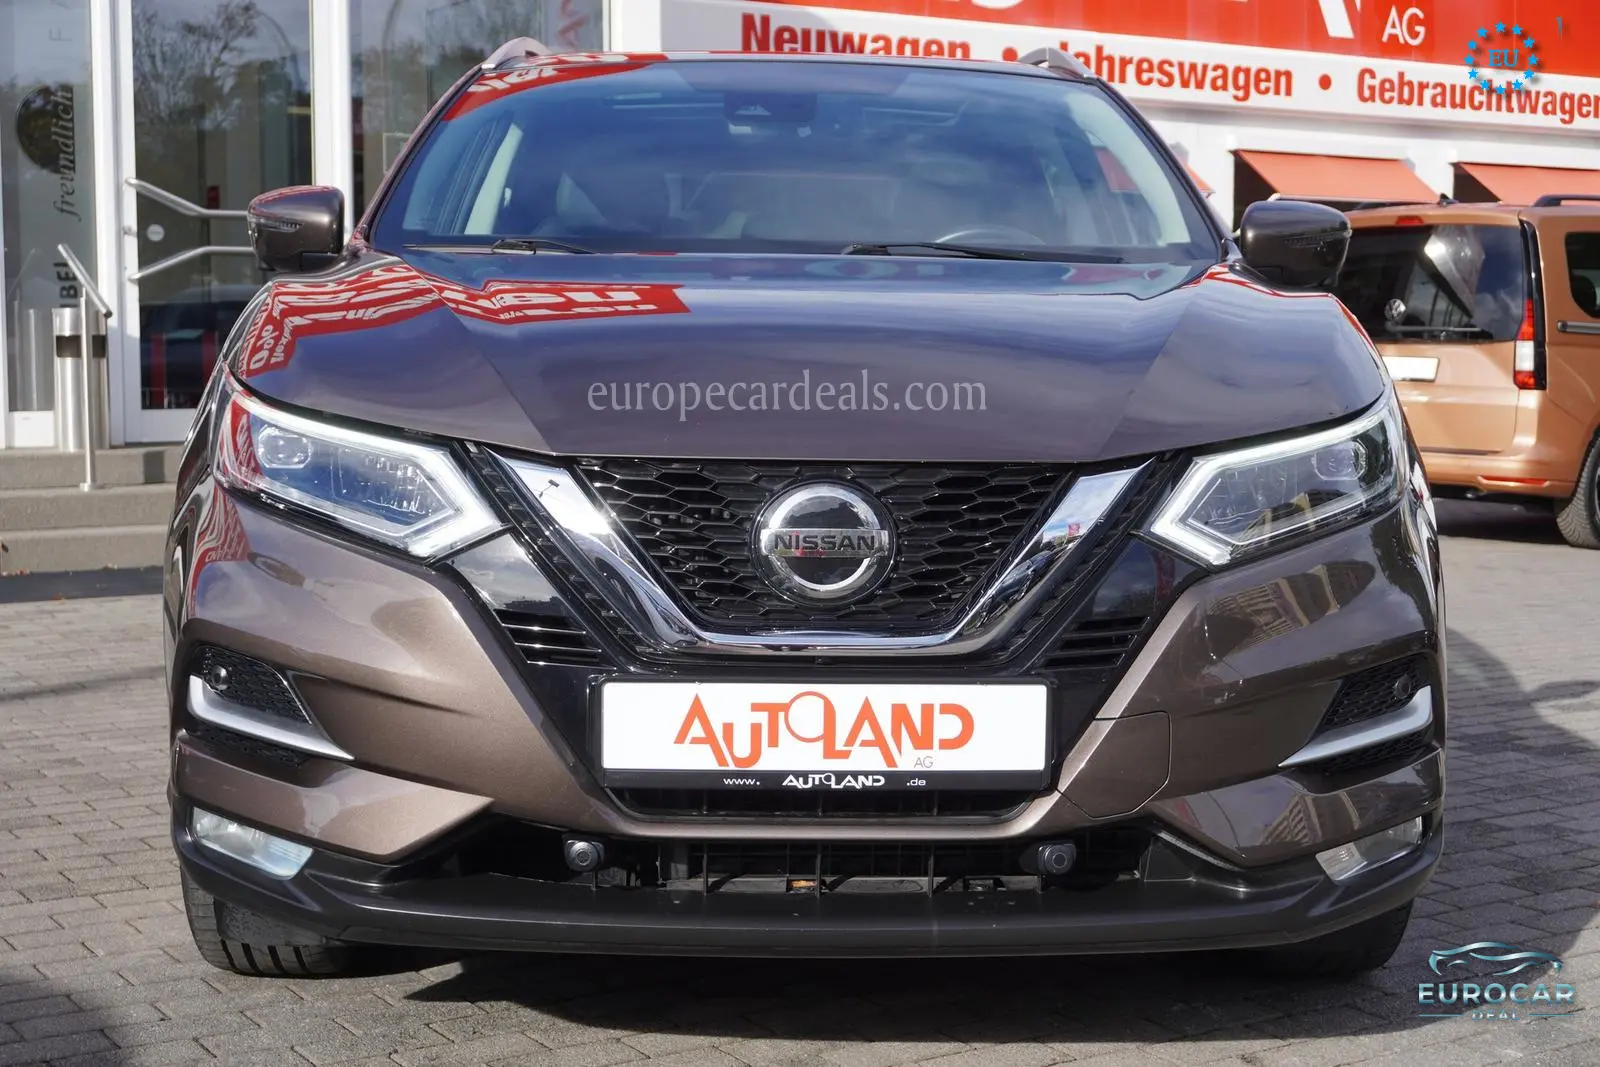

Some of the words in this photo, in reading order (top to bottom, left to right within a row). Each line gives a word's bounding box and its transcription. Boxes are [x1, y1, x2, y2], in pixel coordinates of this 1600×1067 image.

[1381, 5, 1426, 46] AG
[1059, 41, 1293, 102] ahreswagen
[50, 88, 82, 222] freundlich
[775, 534, 875, 551] NISSAN
[913, 757, 934, 769] AG
